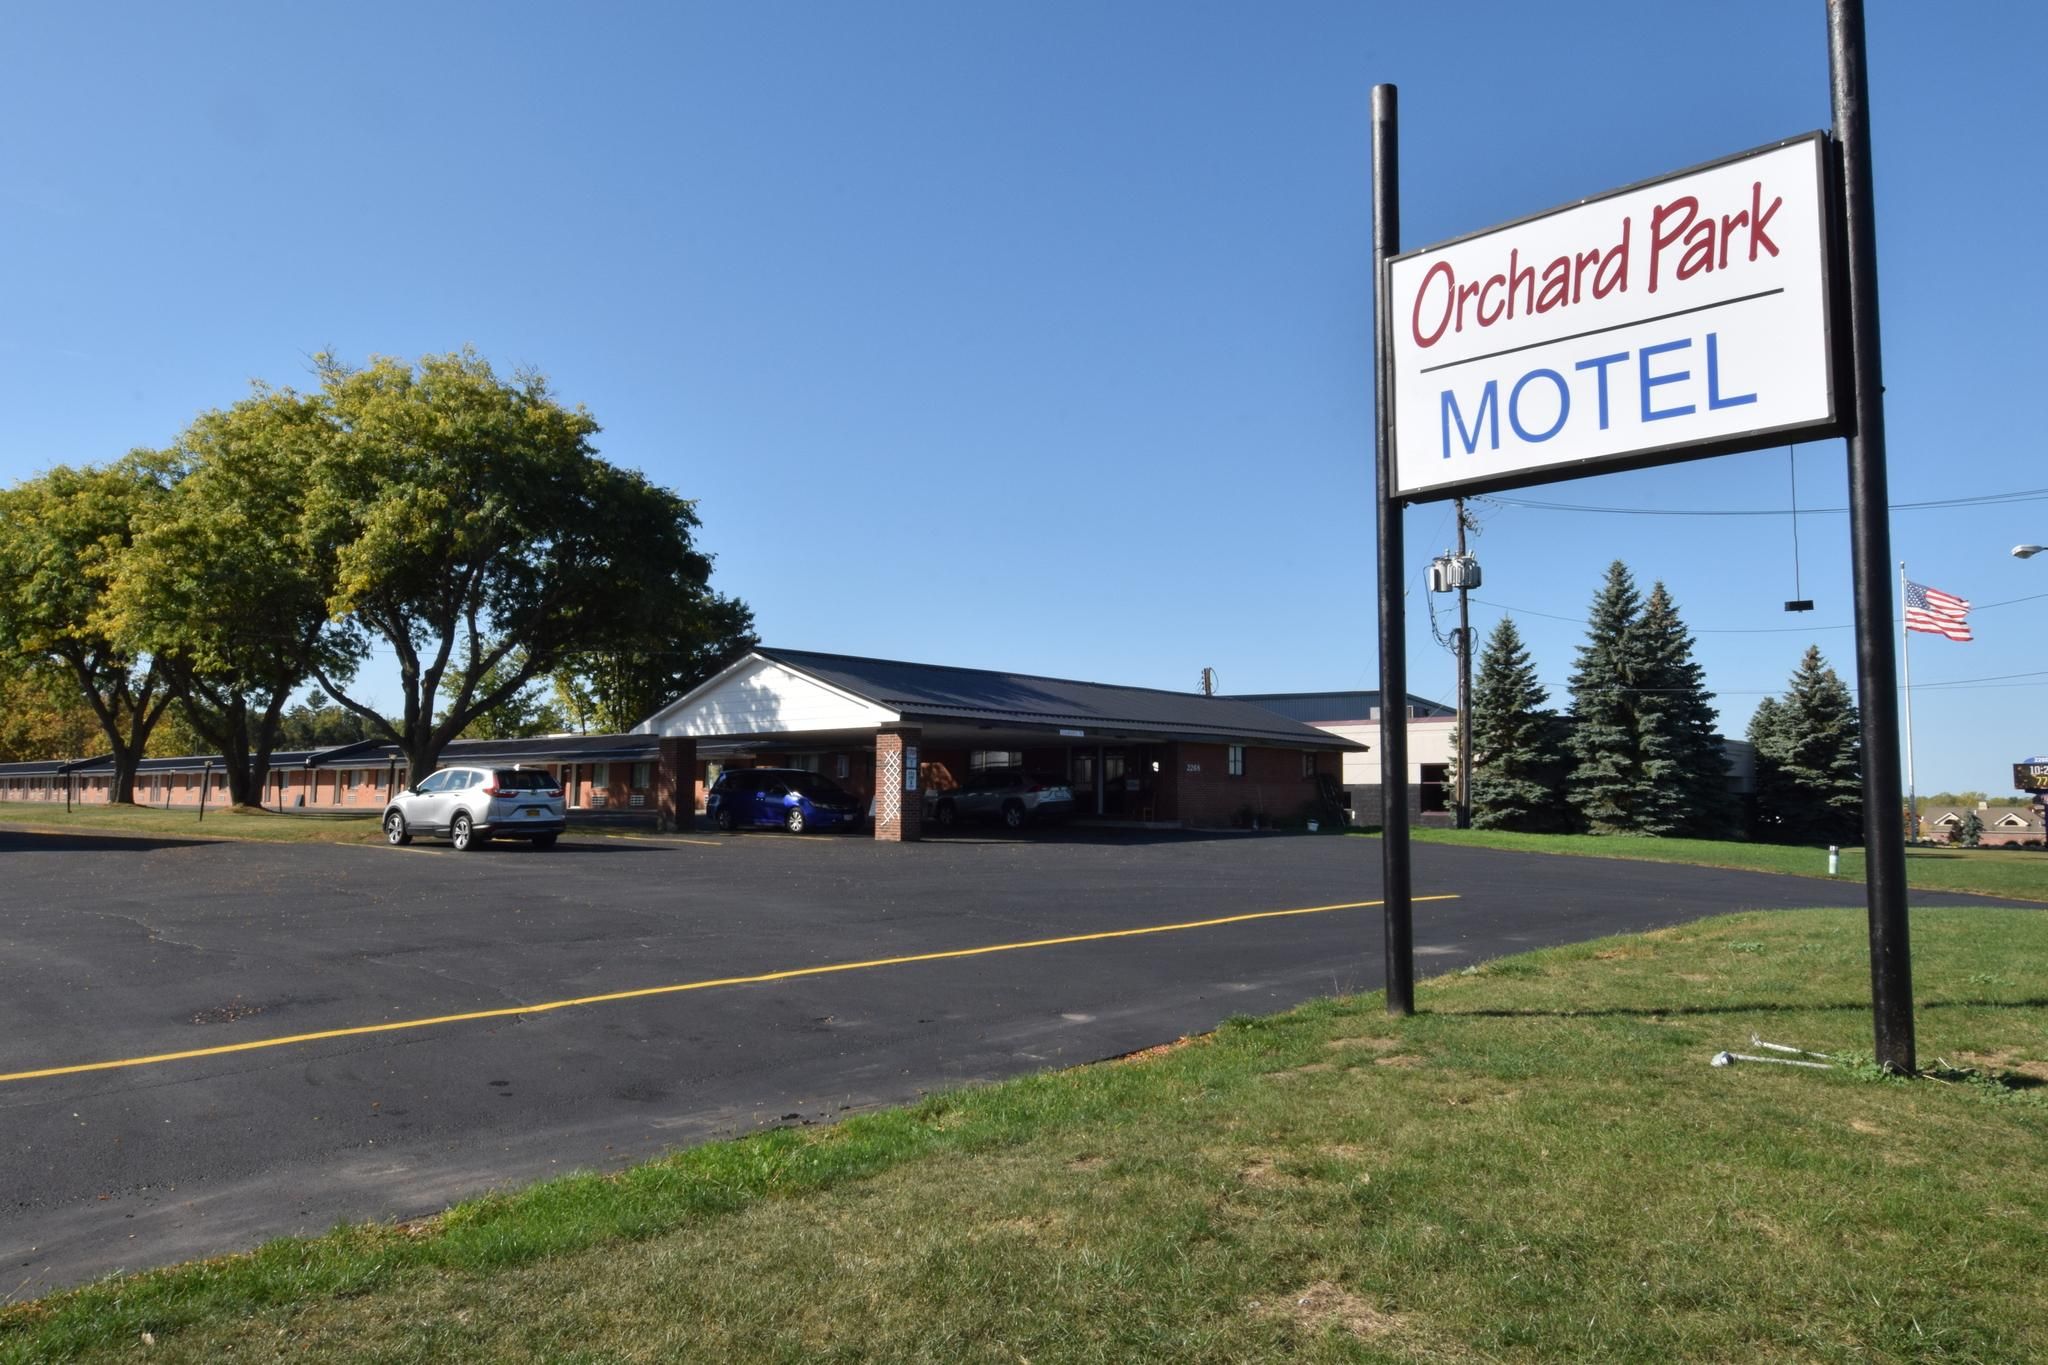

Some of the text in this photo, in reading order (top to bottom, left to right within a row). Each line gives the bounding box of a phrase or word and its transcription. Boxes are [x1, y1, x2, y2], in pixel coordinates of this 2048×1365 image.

[1412, 181, 1783, 349] Orchard Park
[1440, 332, 1758, 459] MOTEL
